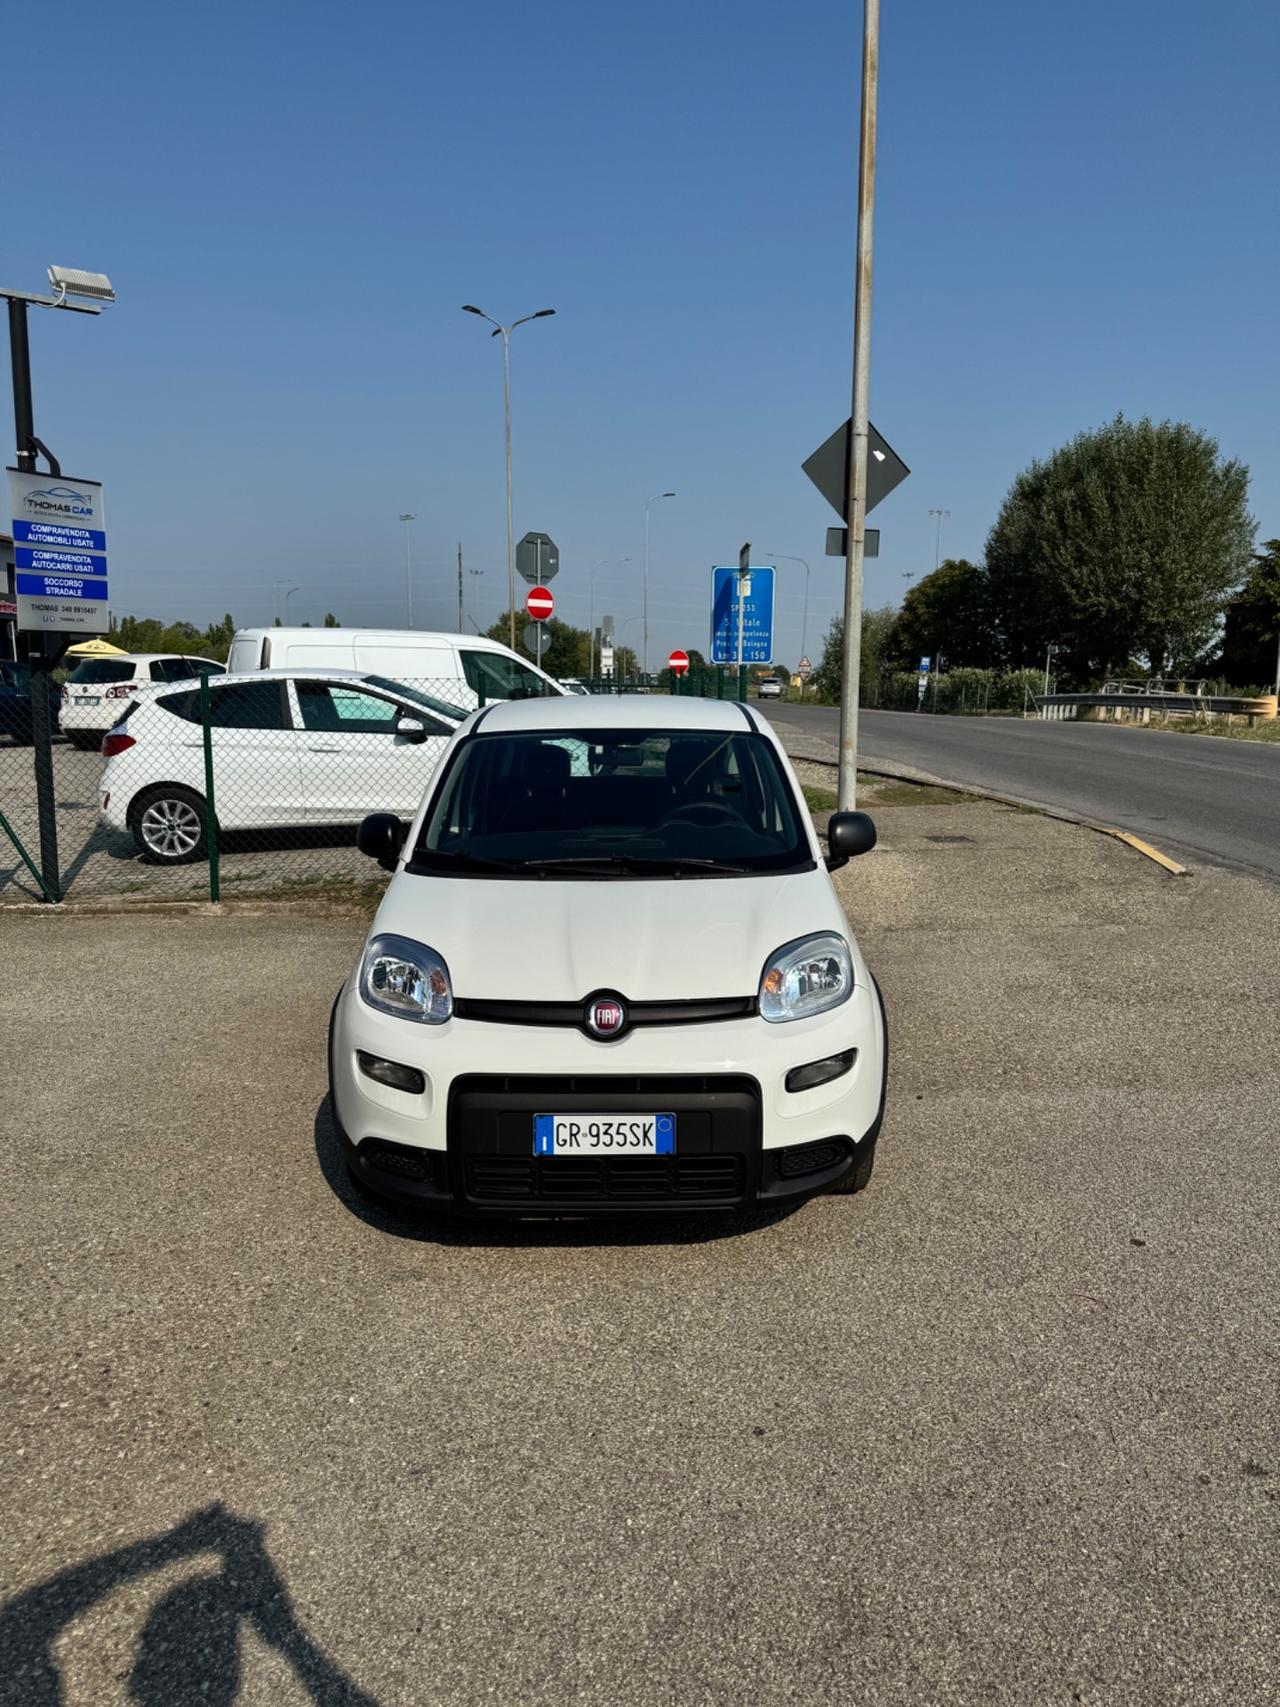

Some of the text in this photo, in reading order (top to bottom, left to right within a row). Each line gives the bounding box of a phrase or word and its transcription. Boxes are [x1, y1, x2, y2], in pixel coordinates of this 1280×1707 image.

[27, 498, 71, 513] THOMAS
[72, 506, 93, 516] CAR
[31, 524, 90, 539] COMPRAVENDITA
[27, 533, 95, 548] AUTOMOBILI USATE
[33, 550, 92, 564] COMPRAVENDITA
[31, 560, 94, 573] AUTOCARRI USATI
[44, 577, 84, 588] SOCCORSO
[45, 586, 83, 597] STRADALE
[31, 603, 59, 613] THOMAS
[750, 650, 766, 660] 150
[596, 1008, 619, 1025] FIAT
